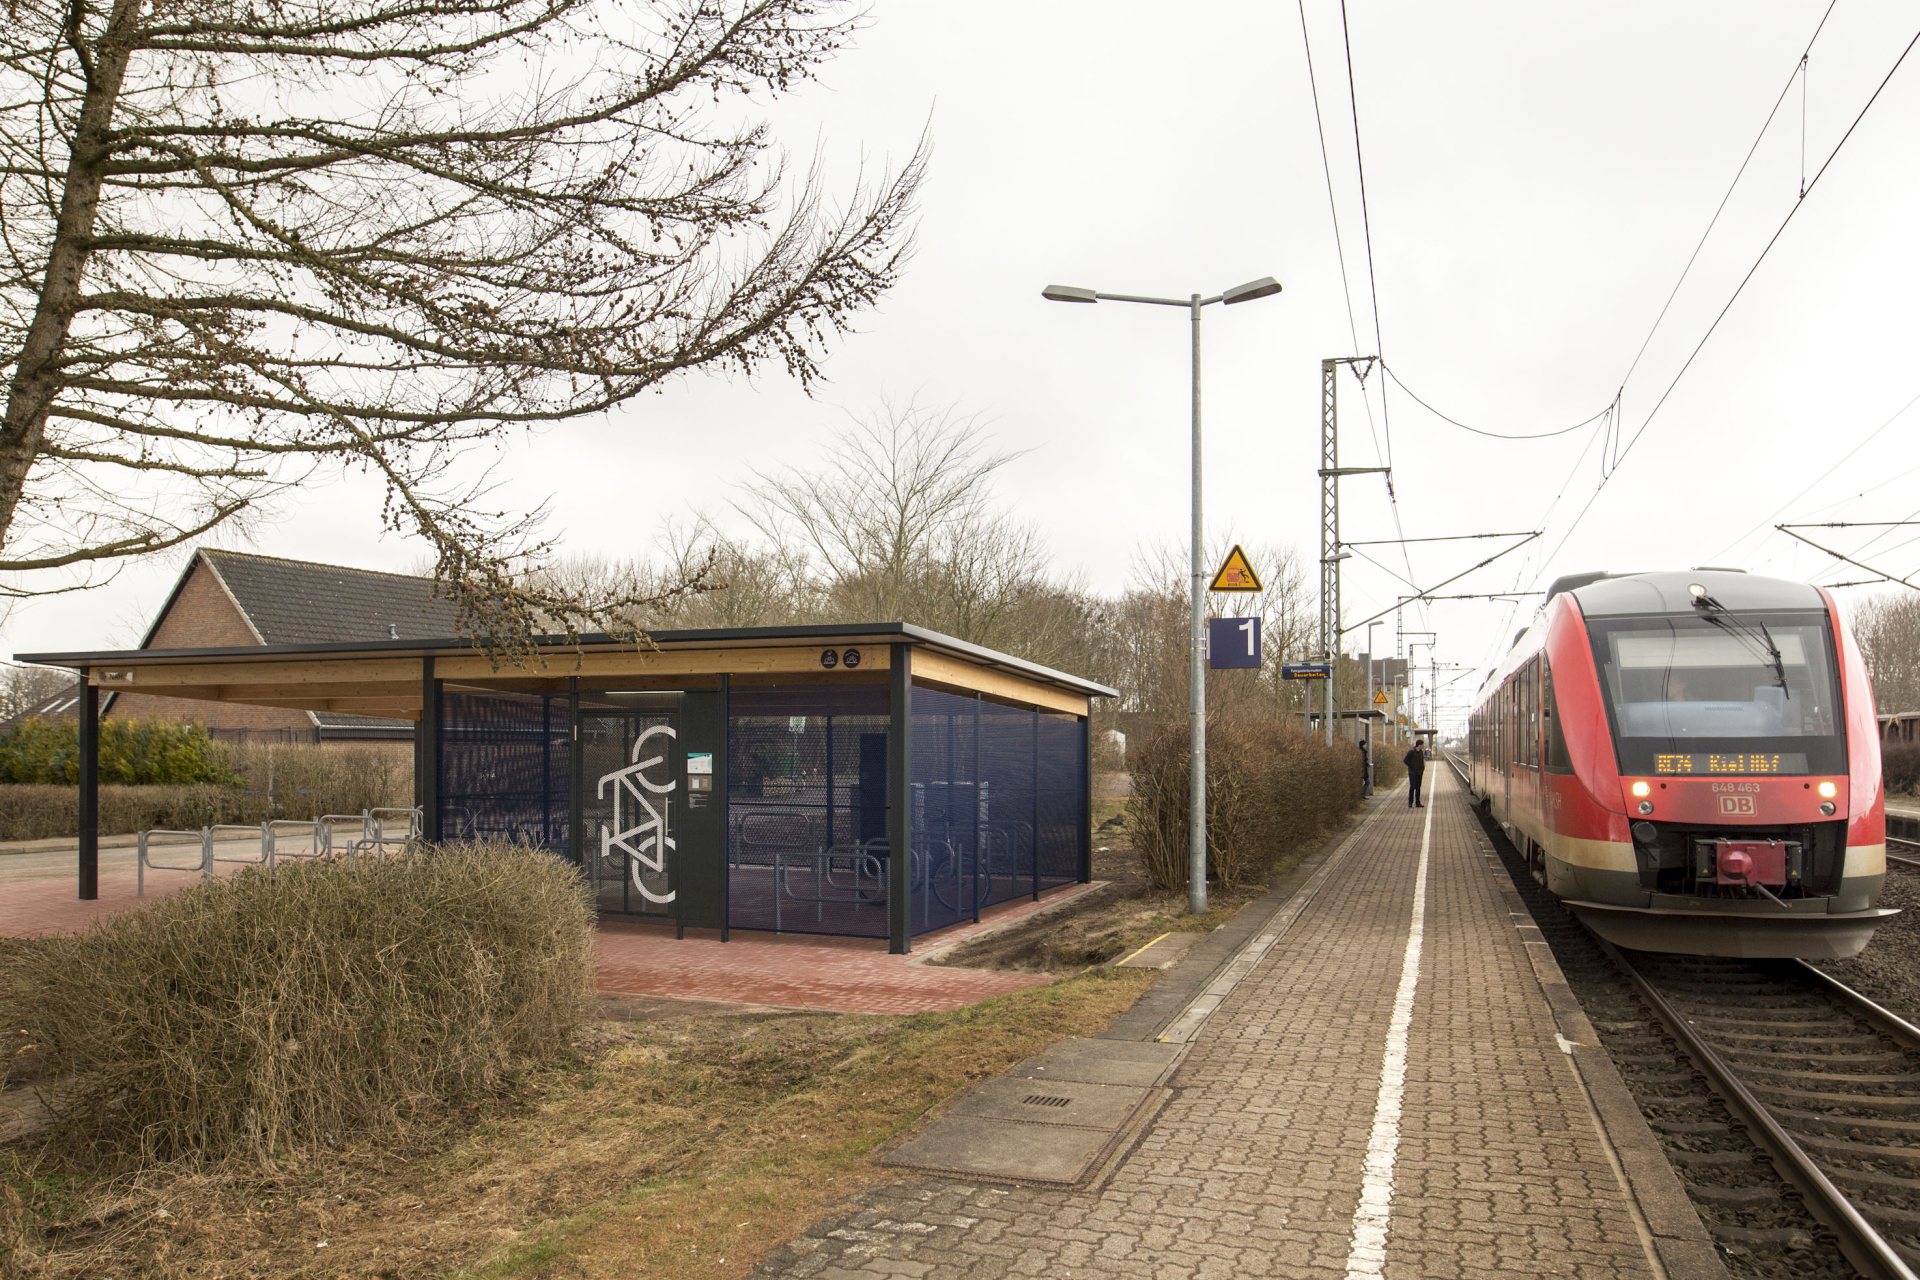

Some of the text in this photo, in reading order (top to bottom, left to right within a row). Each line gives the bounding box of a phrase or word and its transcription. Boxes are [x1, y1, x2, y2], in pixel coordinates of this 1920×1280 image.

[1238, 618, 1254, 656] 1
[1709, 755, 1745, 772] Kiel
[1750, 755, 1780, 772] Hbf
[1711, 783, 1761, 793] 648 463
[1721, 796, 1753, 814] DB
